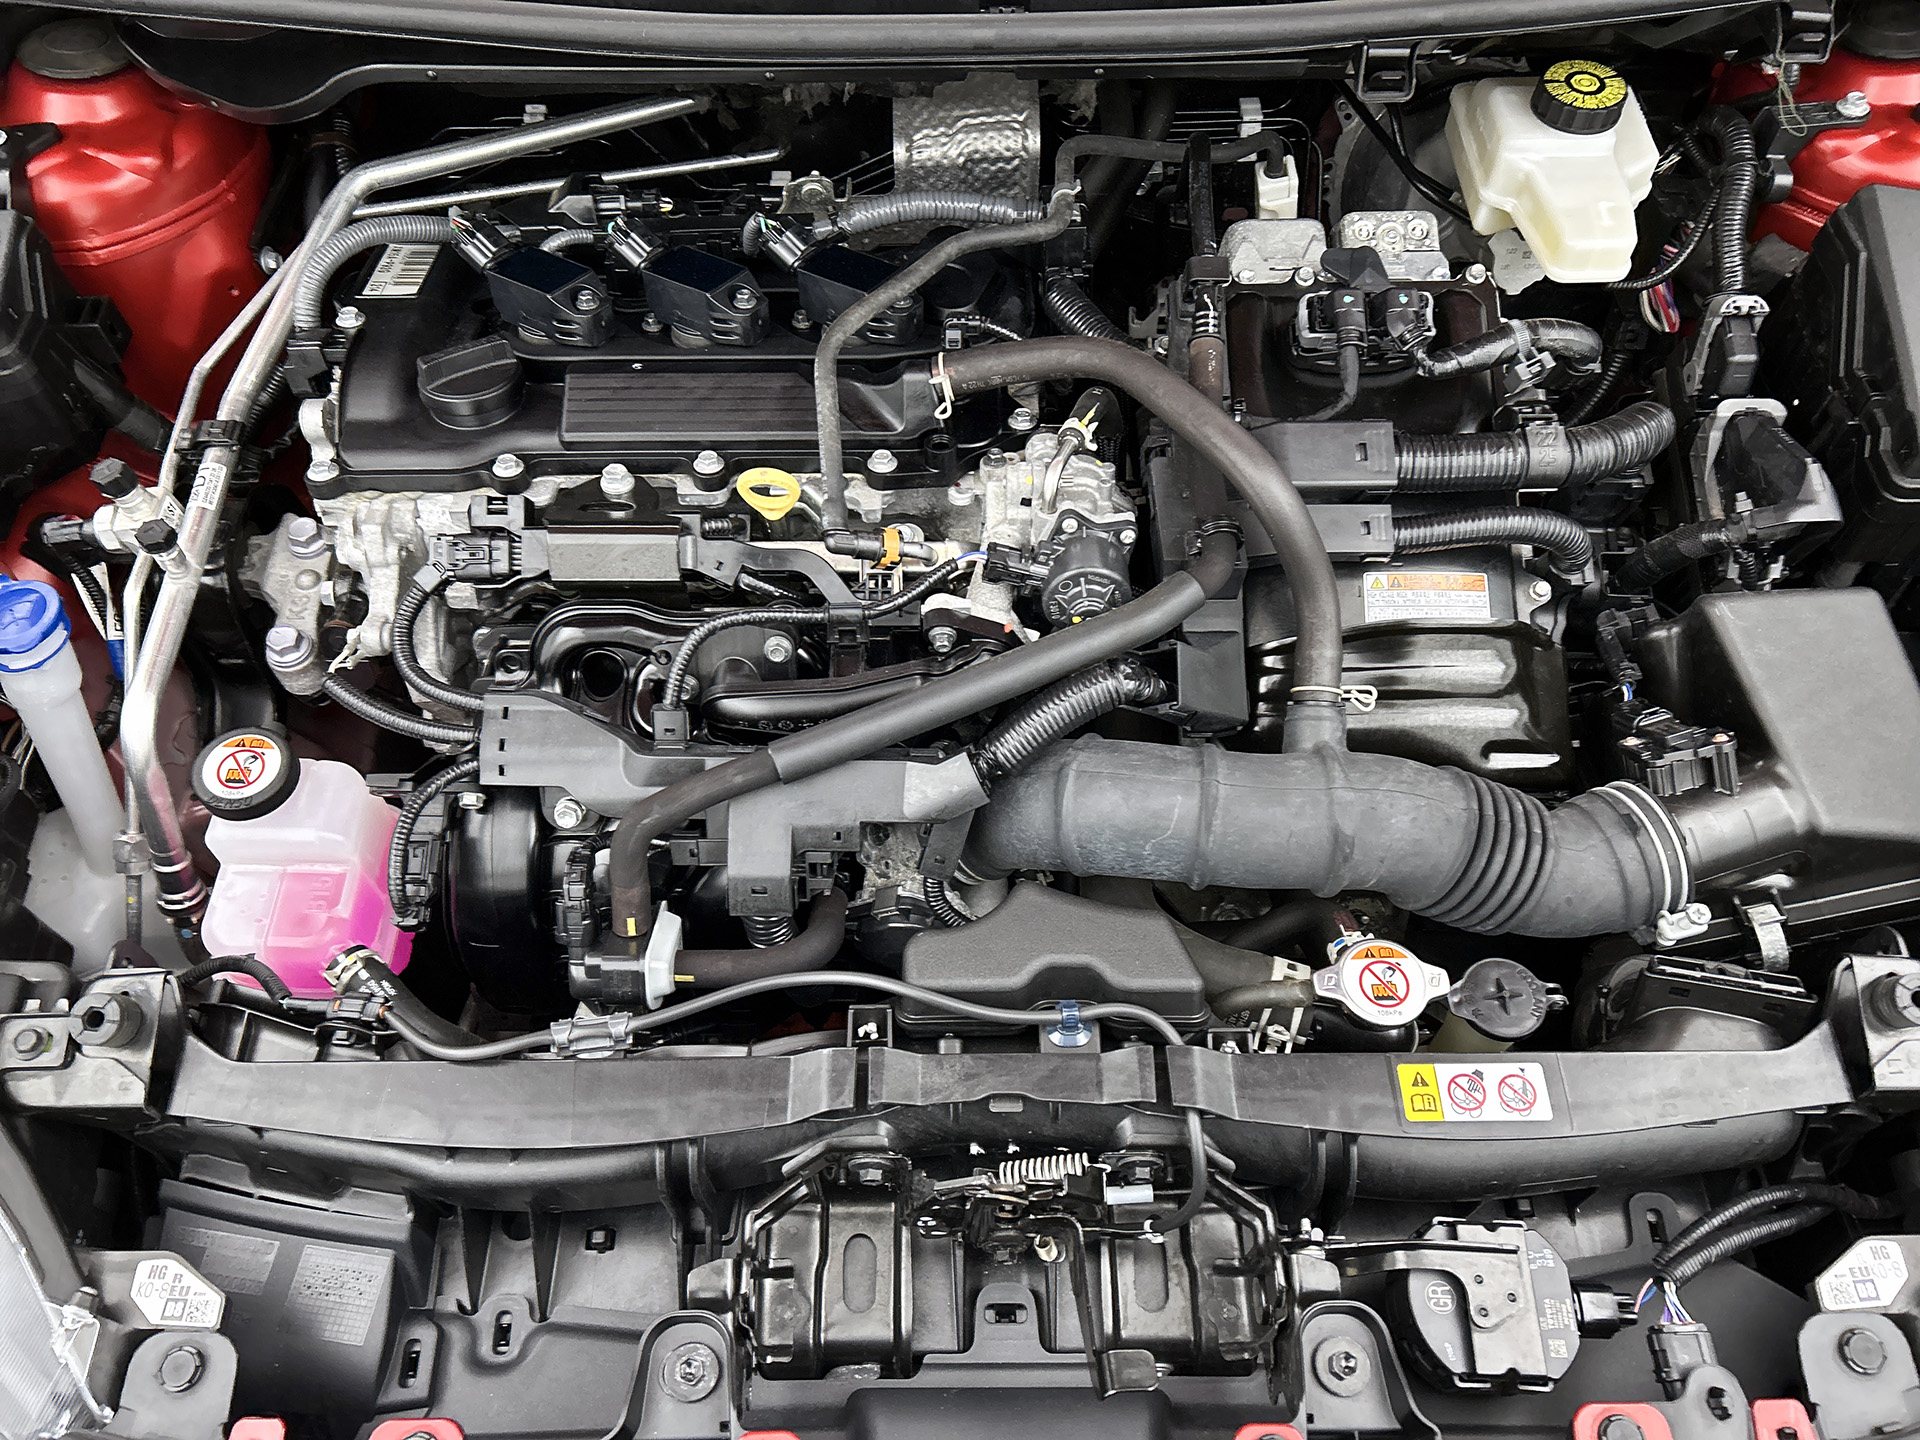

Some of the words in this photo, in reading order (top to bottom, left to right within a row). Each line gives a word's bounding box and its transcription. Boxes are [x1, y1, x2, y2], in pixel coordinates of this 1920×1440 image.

[1538, 448, 1558, 468] 25
[1869, 1244, 1891, 1261] HG
[147, 1264, 169, 1280] HG
[172, 1273, 184, 1284] R
[1848, 1266, 1871, 1279] EU
[168, 1284, 191, 1297] EU
[1428, 1285, 1453, 1312] GR
[1544, 1298, 1556, 1330] TOYOTA
